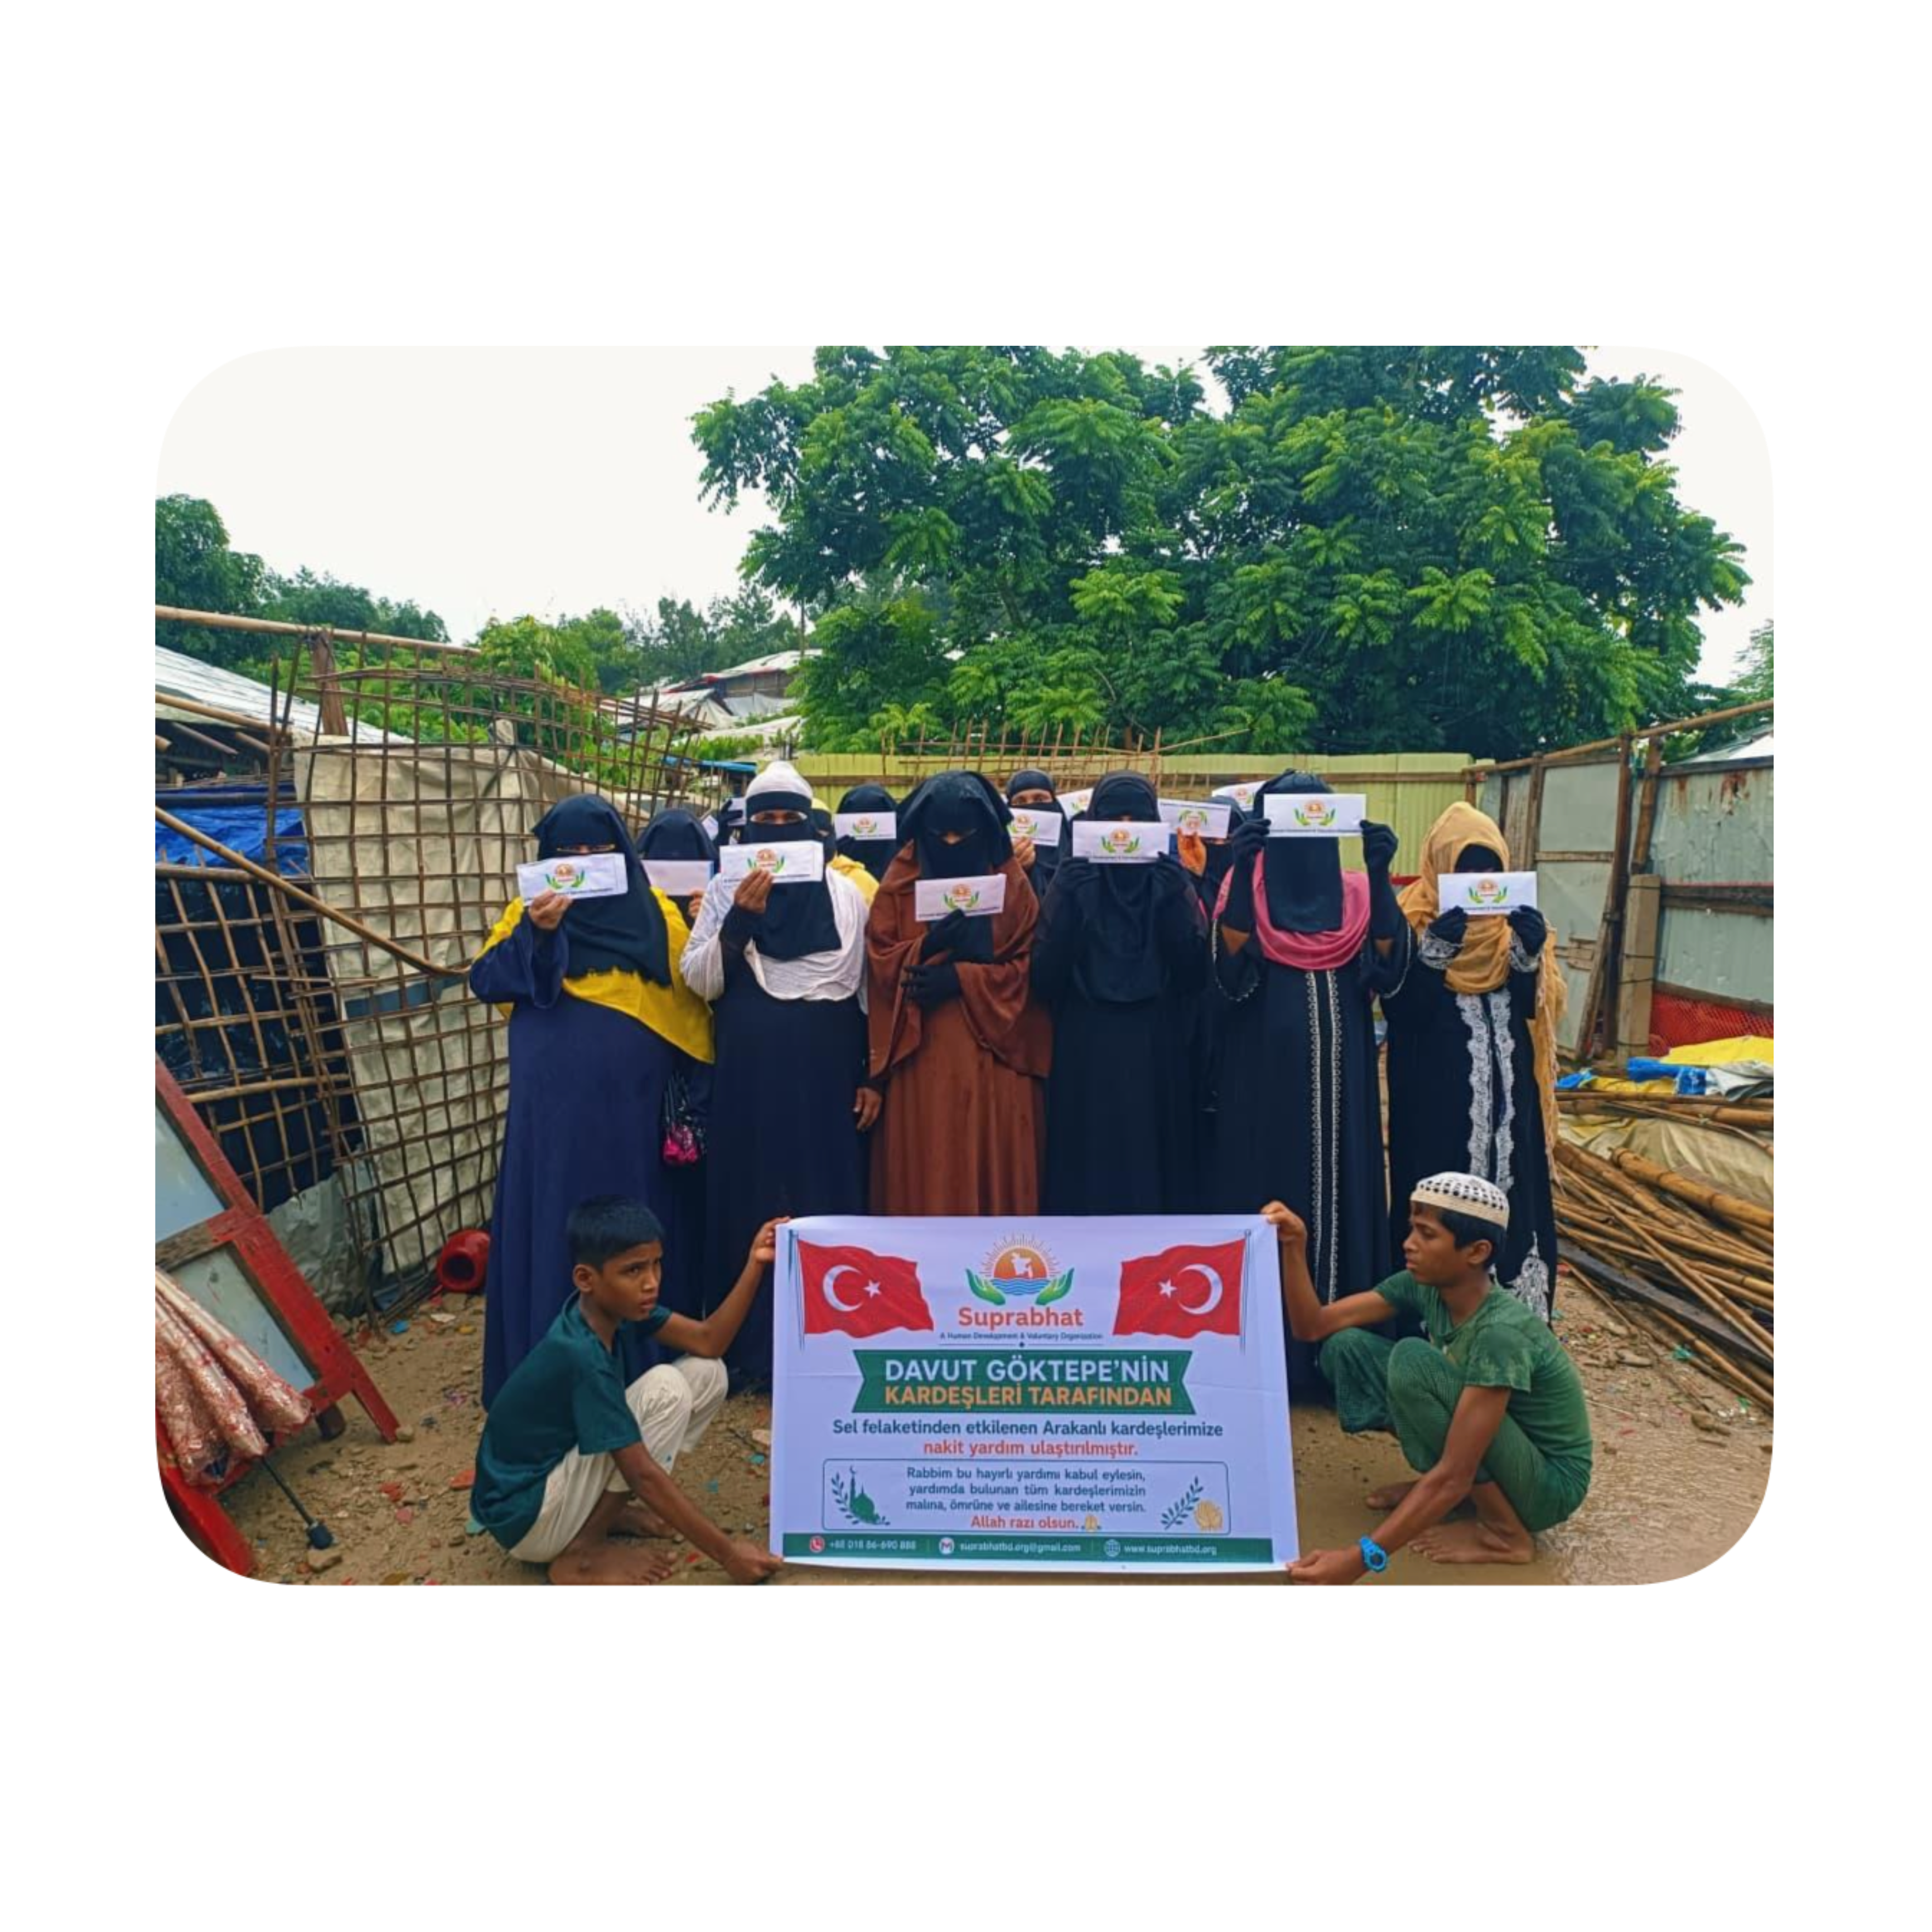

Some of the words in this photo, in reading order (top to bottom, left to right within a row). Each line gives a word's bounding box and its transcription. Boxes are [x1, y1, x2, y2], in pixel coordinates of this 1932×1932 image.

[959, 1306, 1083, 1331] Suprabhat
[885, 1359, 977, 1381] DAVUT
[885, 1382, 1022, 1409] KARDEŞLERİ
[1028, 1387, 1171, 1405] TARAFINDAN
[833, 1419, 858, 1434] Sel
[863, 1419, 961, 1434] felaketinden
[966, 1419, 1037, 1434] etkilenen
[1042, 1420, 1107, 1435] Arakanlı
[1112, 1420, 1223, 1439] kardeşlerimize
[924, 1440, 964, 1455] nakit
[969, 1440, 1025, 1457] yardım
[1031, 1440, 1138, 1459] ulaştırılmıştır.
[907, 1466, 953, 1479] Rabbim
[957, 1467, 972, 1479] bu
[977, 1467, 1013, 1481] hayırlı
[1017, 1468, 1060, 1482] yardımı
[1065, 1468, 1098, 1480] kabul
[1102, 1469, 1146, 1482] eylesin,
[909, 1483, 965, 1496] yardımda
[970, 1483, 1019, 1494] bulunan
[1025, 1484, 1049, 1495] tüm
[1054, 1484, 1146, 1499] kardeşlerimizin
[906, 1499, 947, 1511] malına,
[950, 1499, 994, 1510] ömrüne
[997, 1501, 1011, 1511] ve
[1014, 1499, 1057, 1511] ailesine
[1061, 1500, 1105, 1512] bereket
[1109, 1501, 1146, 1512] versin.
[971, 1515, 1006, 1528] Allah
[1010, 1518, 1035, 1528] razı
[1039, 1515, 1079, 1529] olsun.
